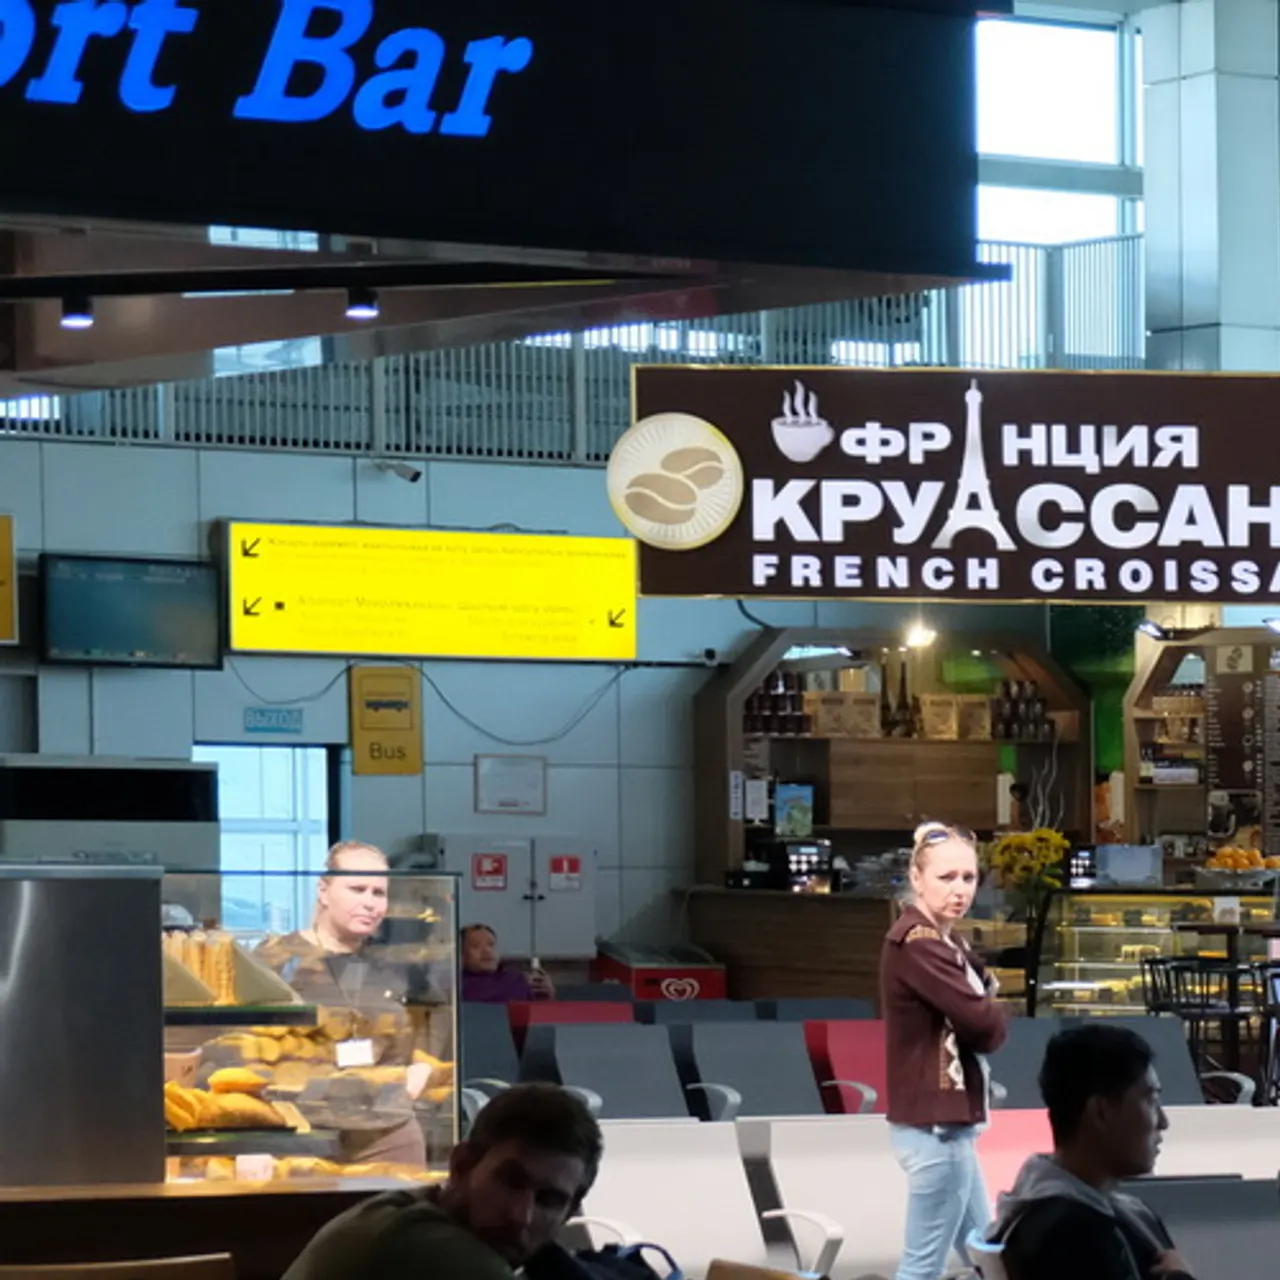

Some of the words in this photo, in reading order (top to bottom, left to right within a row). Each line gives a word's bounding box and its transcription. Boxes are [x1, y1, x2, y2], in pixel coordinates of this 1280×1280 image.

[232, 0, 534, 138] Bar
[752, 555, 1000, 589] FRENCH
[245, 708, 302, 730] ВЫХОД
[369, 743, 407, 760] Bus
